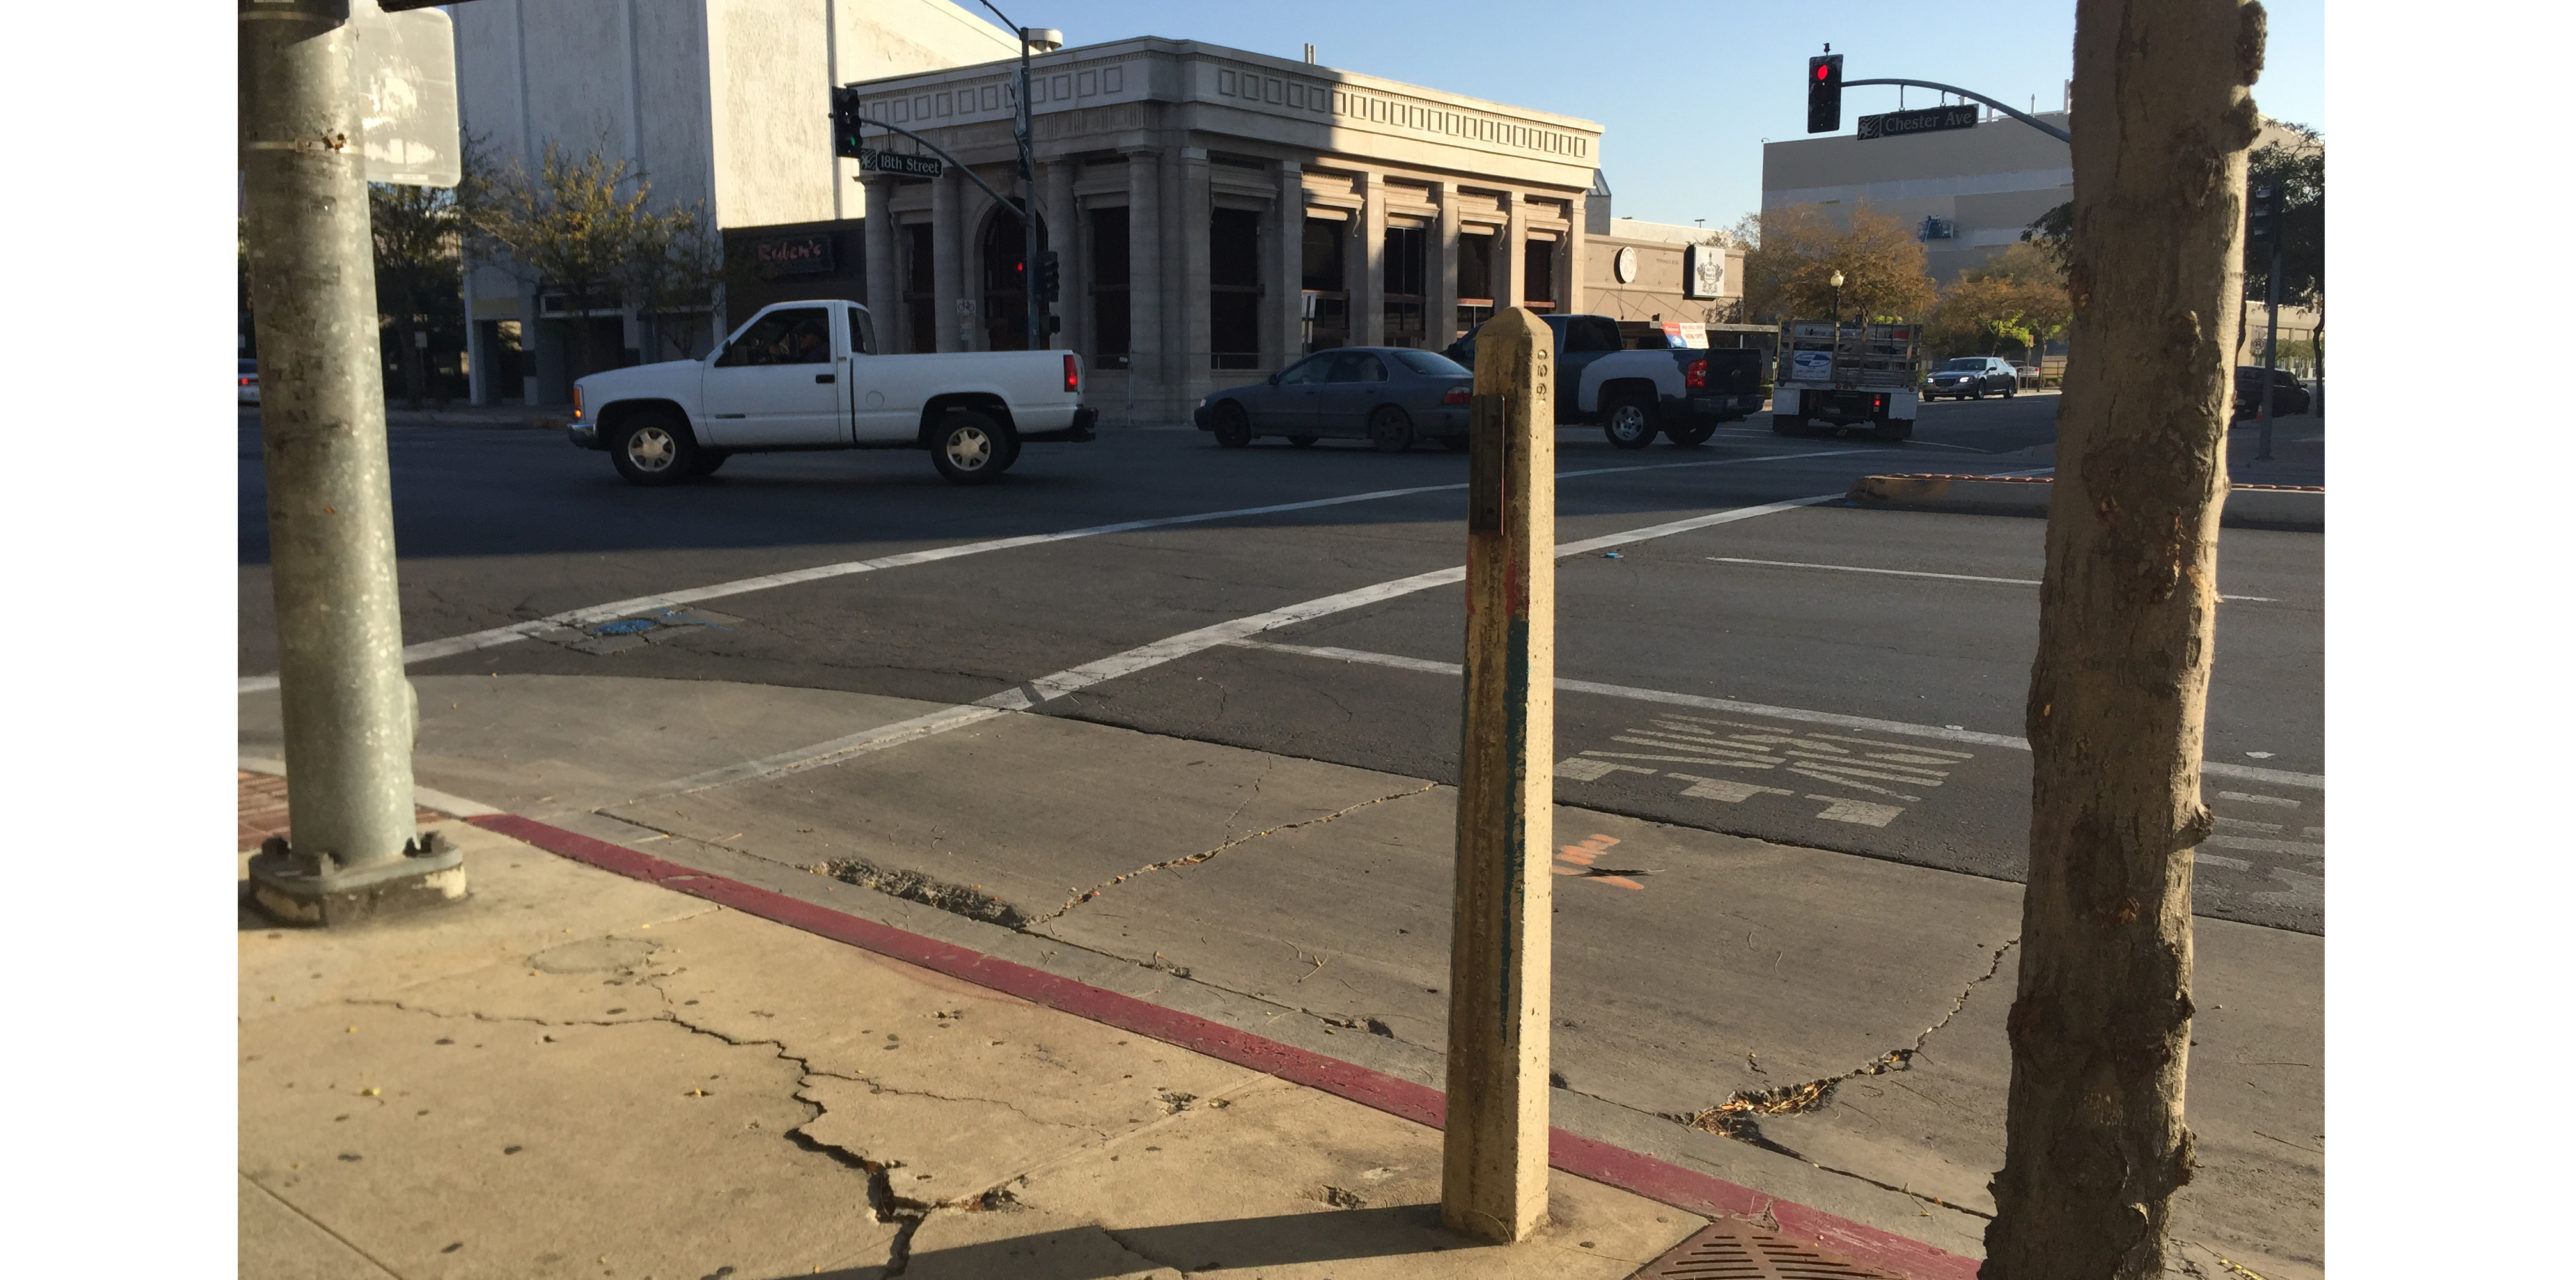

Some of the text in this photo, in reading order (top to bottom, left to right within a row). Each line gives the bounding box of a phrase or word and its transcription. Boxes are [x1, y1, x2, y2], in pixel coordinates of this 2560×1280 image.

[1885, 111, 1972, 132] Chester Ave
[881, 154, 939, 174] 18th Street
